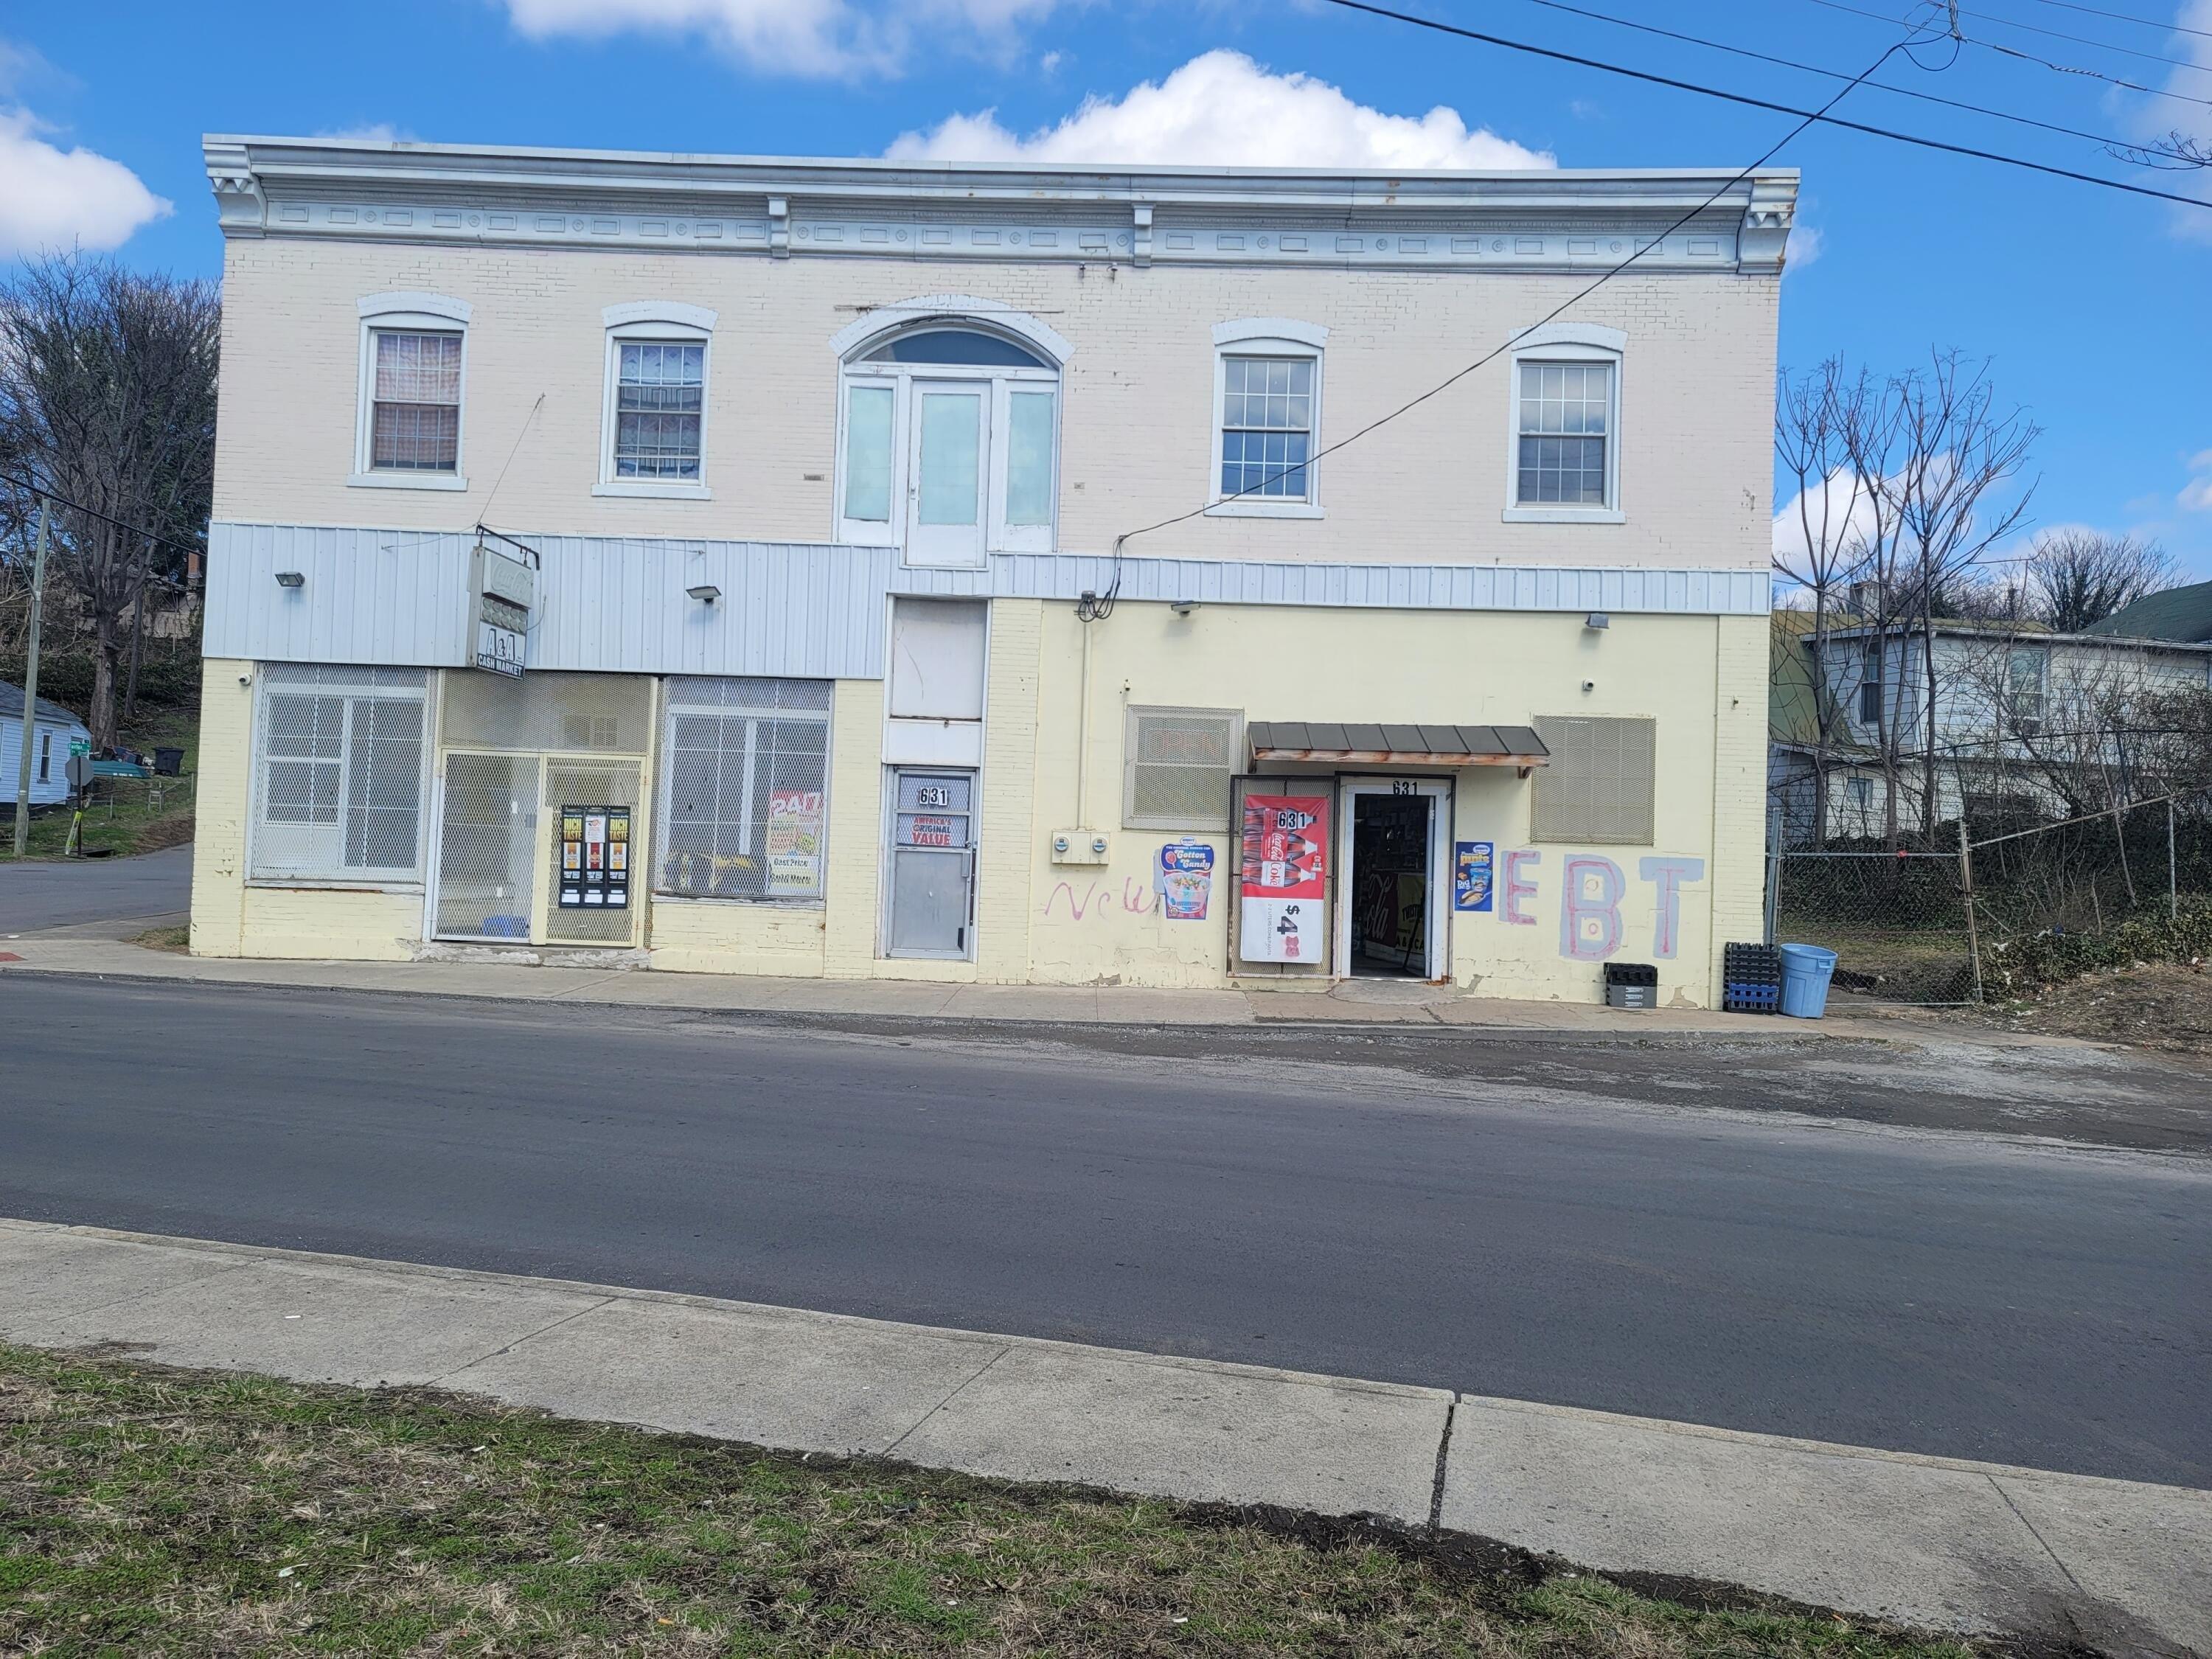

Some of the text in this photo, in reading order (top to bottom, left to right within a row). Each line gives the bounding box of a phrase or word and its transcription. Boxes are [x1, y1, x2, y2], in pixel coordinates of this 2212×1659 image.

[486, 628, 515, 662] A&A
[478, 655, 522, 676] CASH MARKET
[1393, 781, 1418, 796] 631
[920, 788, 946, 804] 631
[564, 818, 582, 831] RICH
[610, 818, 628, 831] RICH
[914, 817, 952, 825] AMERICA'S
[1279, 813, 1306, 828] 631
[563, 830, 582, 841] TASTE
[913, 824, 951, 833] ORIGINAL
[609, 831, 628, 841] TASTE
[912, 832, 950, 846] VALUE
[1271, 832, 1284, 861] Coca-Cola
[1175, 849, 1206, 859] Cotton
[1180, 859, 1211, 870] Candy
[1270, 862, 1281, 886] Coke
[1498, 850, 1705, 961] EBT
